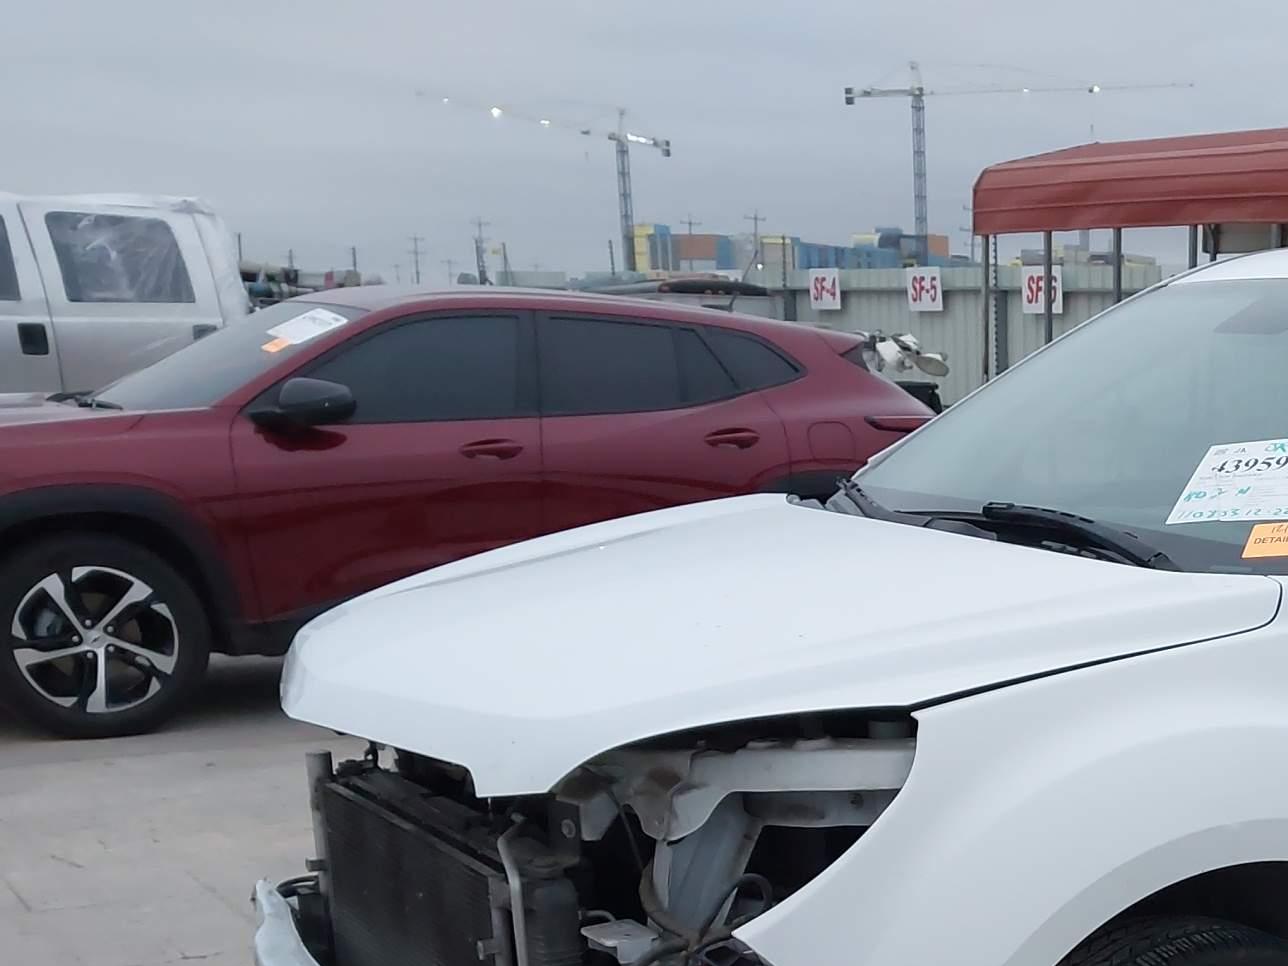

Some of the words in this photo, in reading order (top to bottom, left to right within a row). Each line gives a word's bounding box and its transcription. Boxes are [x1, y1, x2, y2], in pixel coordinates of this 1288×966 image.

[813, 276, 836, 301] SF-4
[911, 275, 937, 302] SF-5
[1026, 275, 1057, 304] SF6
